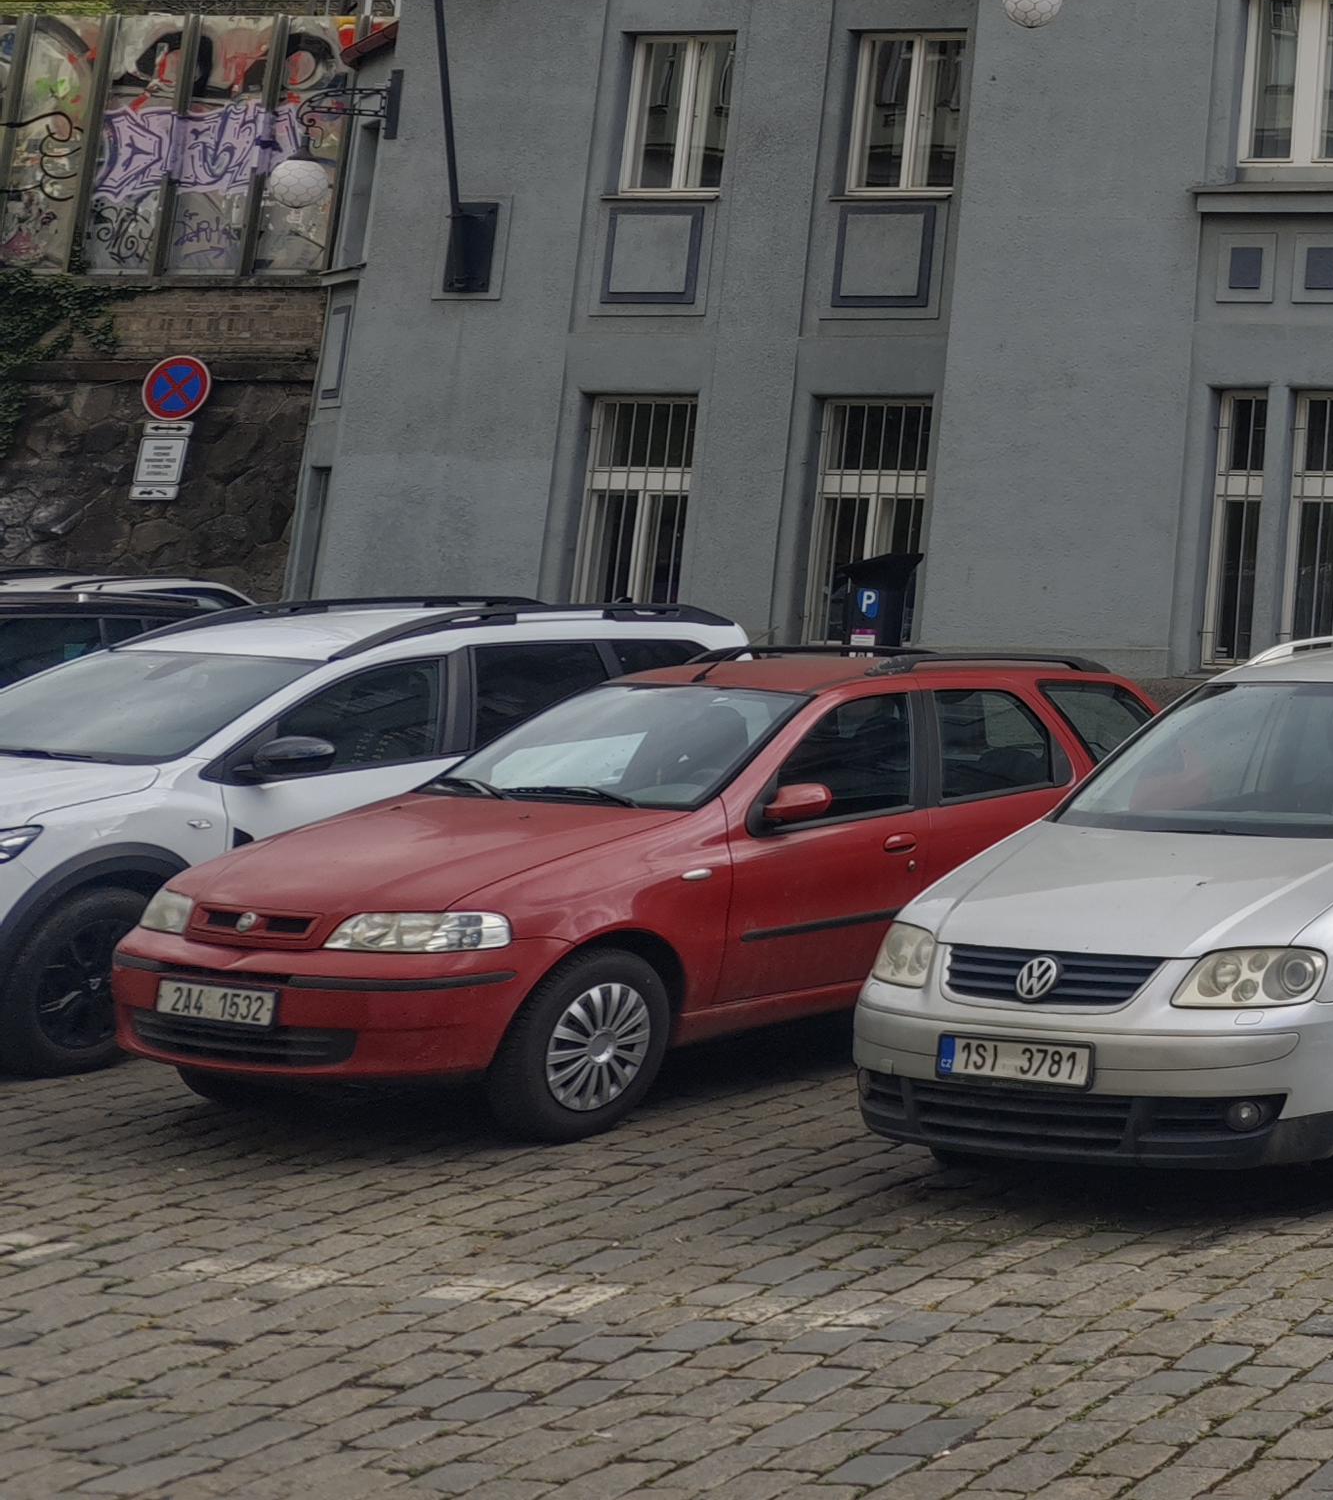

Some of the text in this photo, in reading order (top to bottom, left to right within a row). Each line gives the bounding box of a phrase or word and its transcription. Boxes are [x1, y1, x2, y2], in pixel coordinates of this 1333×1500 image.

[171, 987, 264, 1022] 2A4 1532
[941, 1058, 953, 1069] CZ
[1019, 1047, 1077, 1080] 3781
